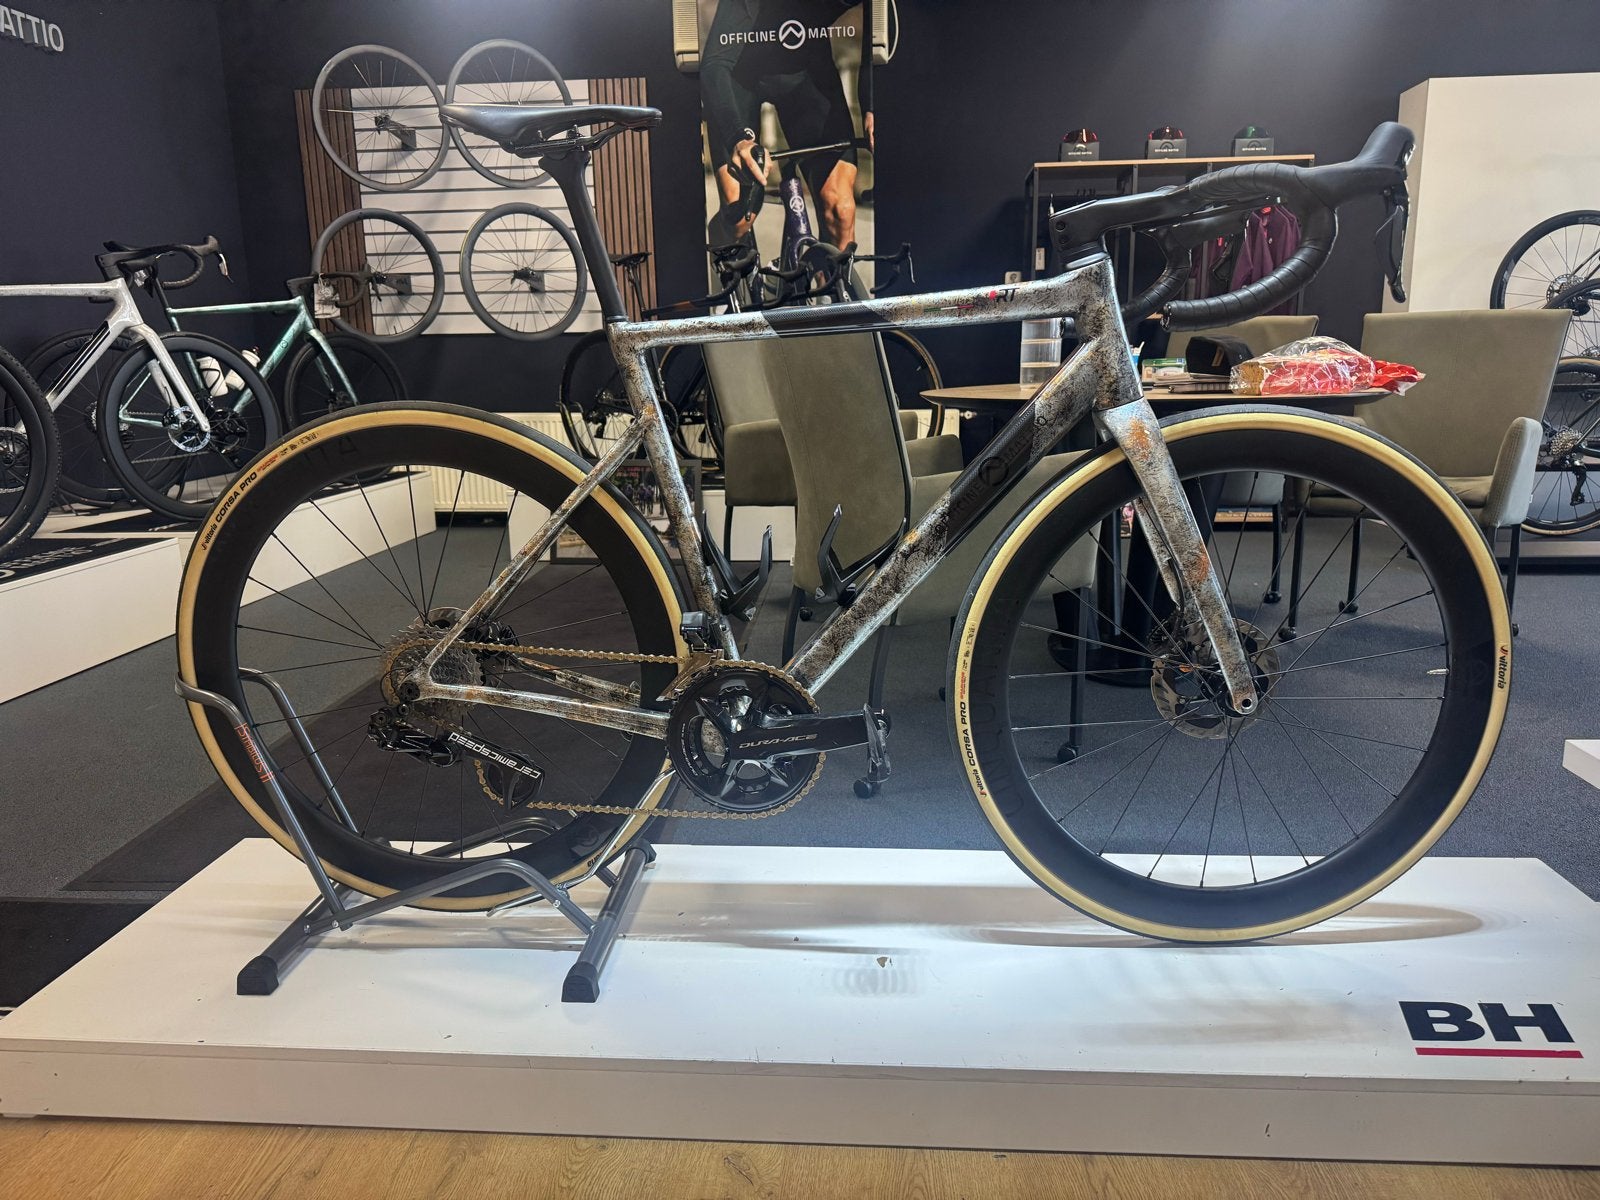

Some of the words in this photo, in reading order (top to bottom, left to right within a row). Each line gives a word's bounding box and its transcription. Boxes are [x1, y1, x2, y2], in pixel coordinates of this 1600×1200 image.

[0, 5, 64, 52] ATTIO
[720, 30, 776, 45] OFFICINE
[808, 26, 856, 39] MATTIO
[203, 523, 218, 546] vittoria
[215, 491, 241, 523] CORSA
[240, 471, 258, 491] PRO
[1497, 655, 1508, 689] vittoria
[960, 701, 968, 725] PRO
[447, 732, 541, 779] ceramicspeed
[739, 733, 818, 749] DURA-ACE
[963, 728, 976, 767] CORSA
[1399, 1001, 1575, 1042] BH
